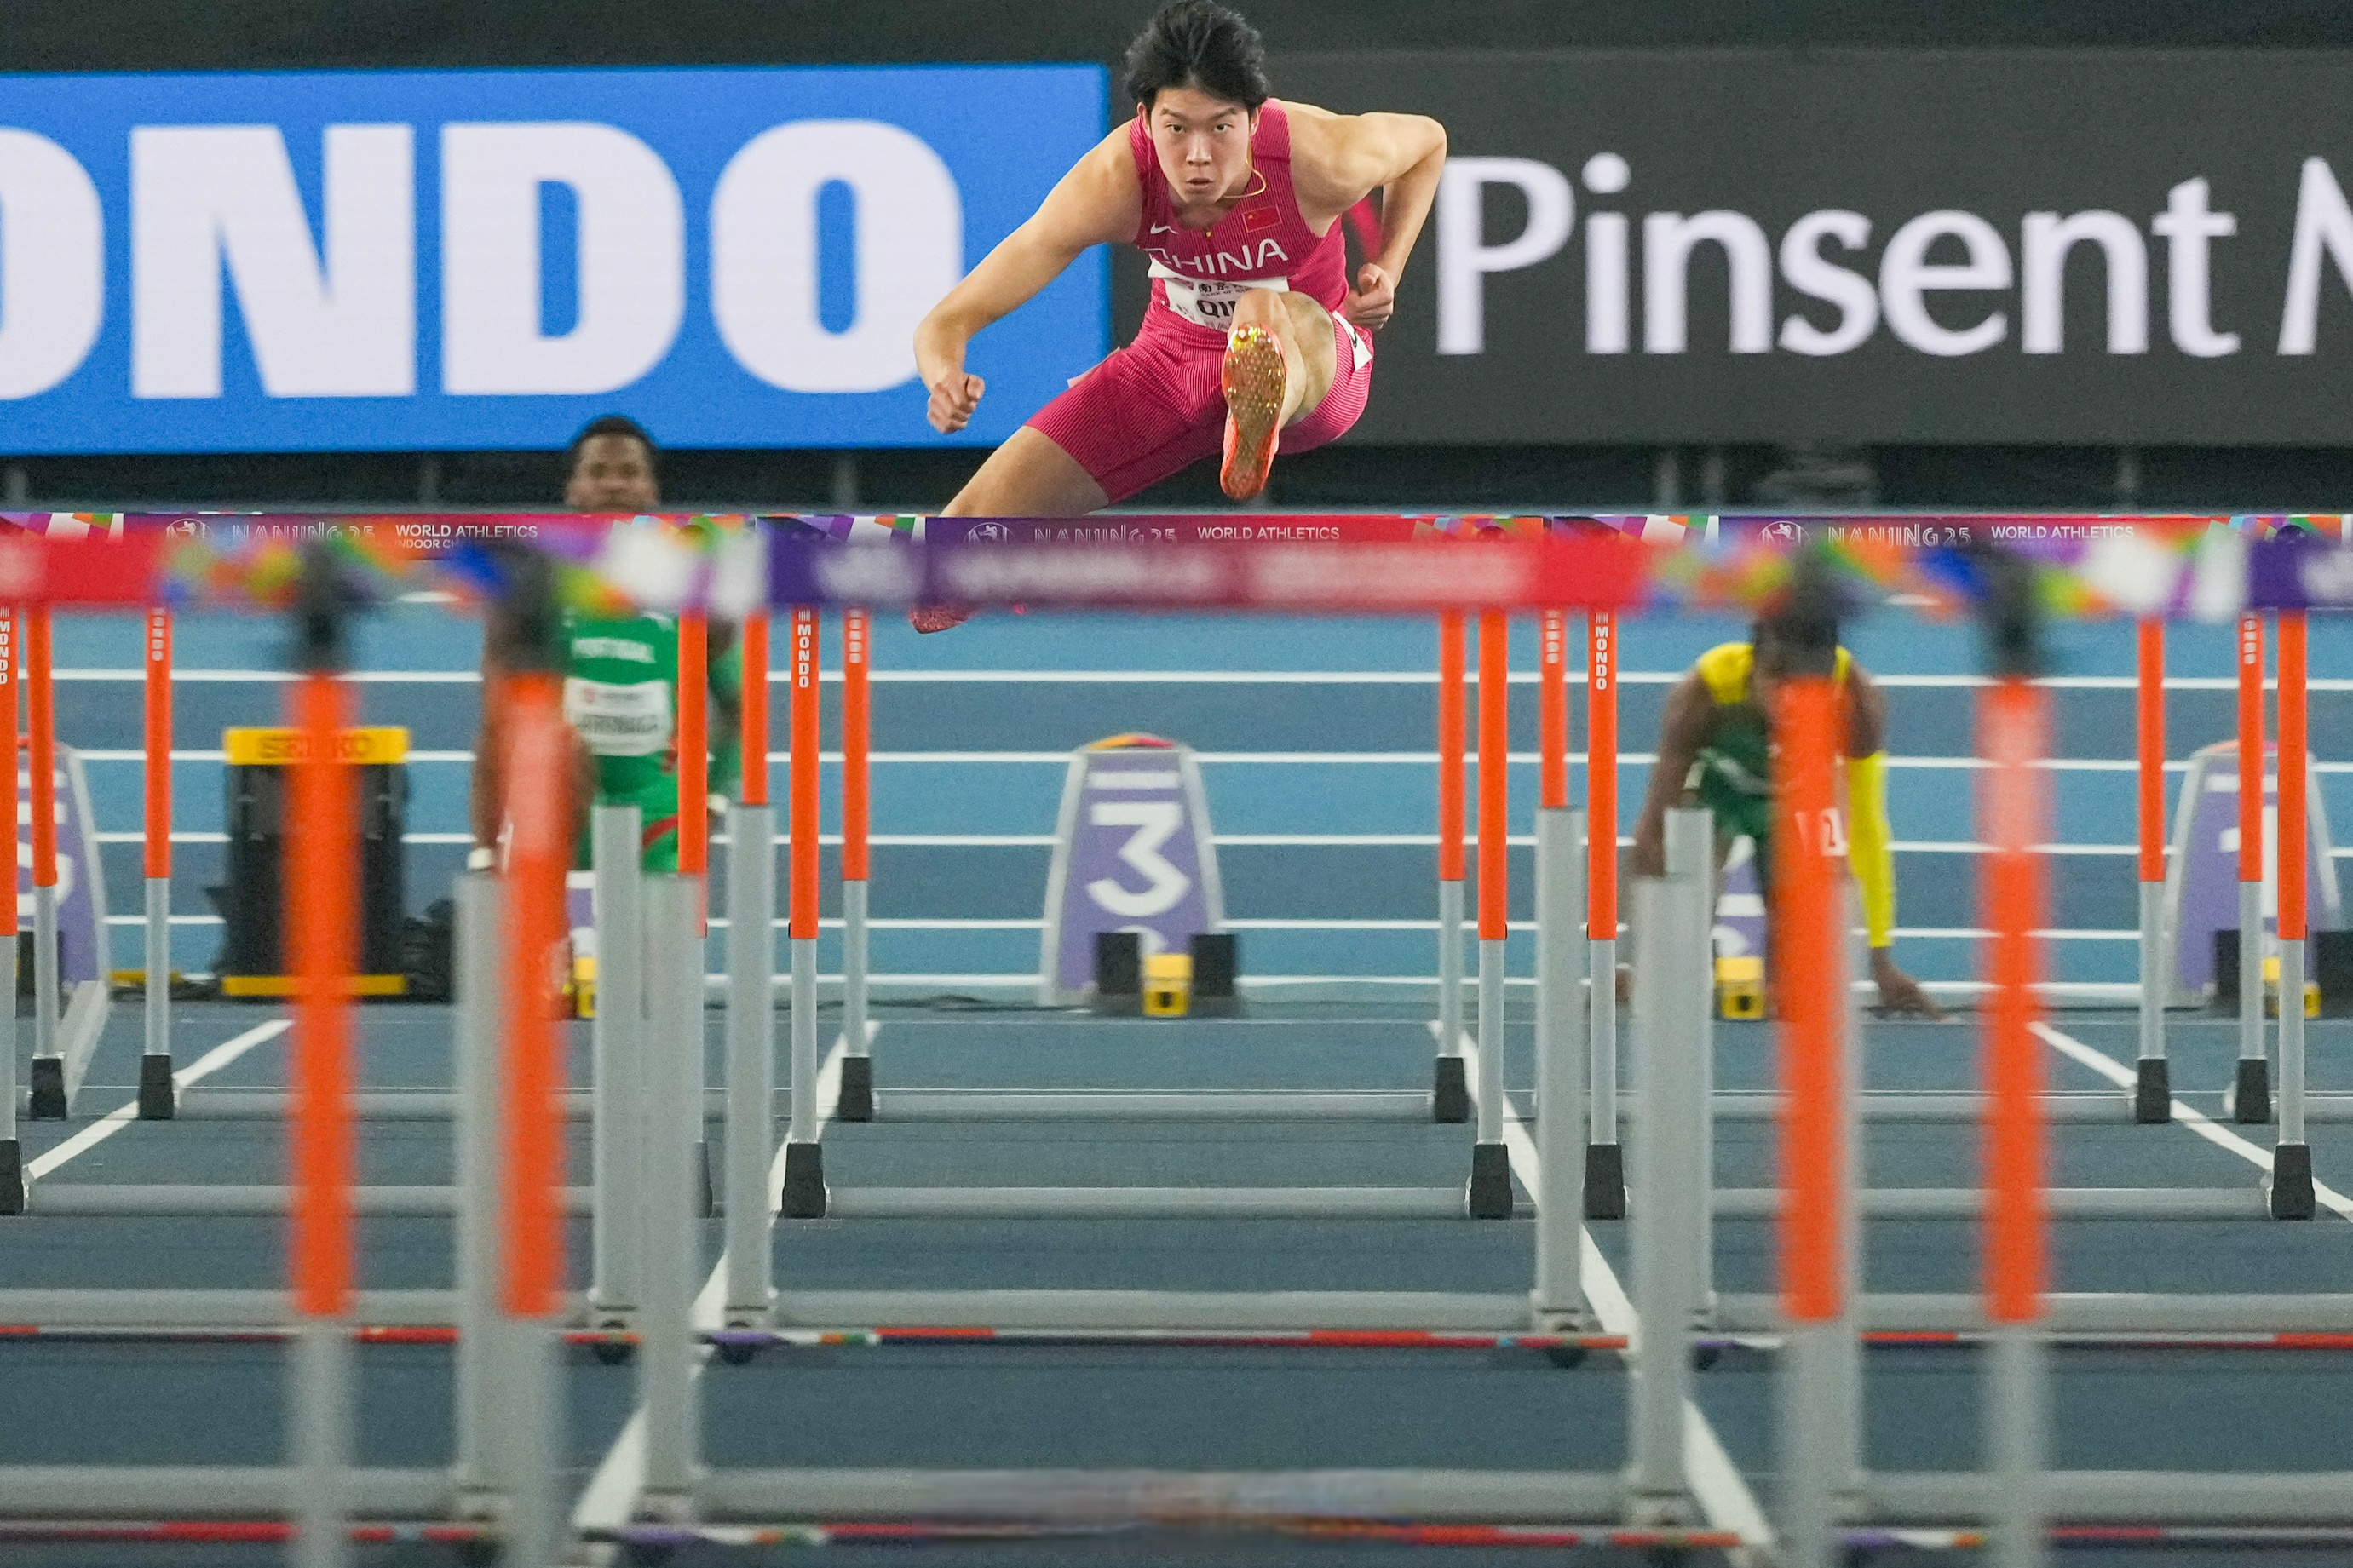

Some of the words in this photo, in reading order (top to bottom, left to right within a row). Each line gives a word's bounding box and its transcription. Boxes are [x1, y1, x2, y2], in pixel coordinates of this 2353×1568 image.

[1435, 152, 2241, 358] Pinsent
[395, 524, 452, 537] WORLD
[455, 524, 538, 538] ATHLETICS
[1197, 526, 1252, 540] WORLD
[1257, 526, 1341, 540] ATHLETICS
[1991, 526, 2047, 539] WORLD
[2051, 526, 2135, 539] ATHLETICS
[797, 624, 812, 688] MONDO
[1595, 626, 1609, 690] MONDO
[1087, 802, 1191, 917] 3
